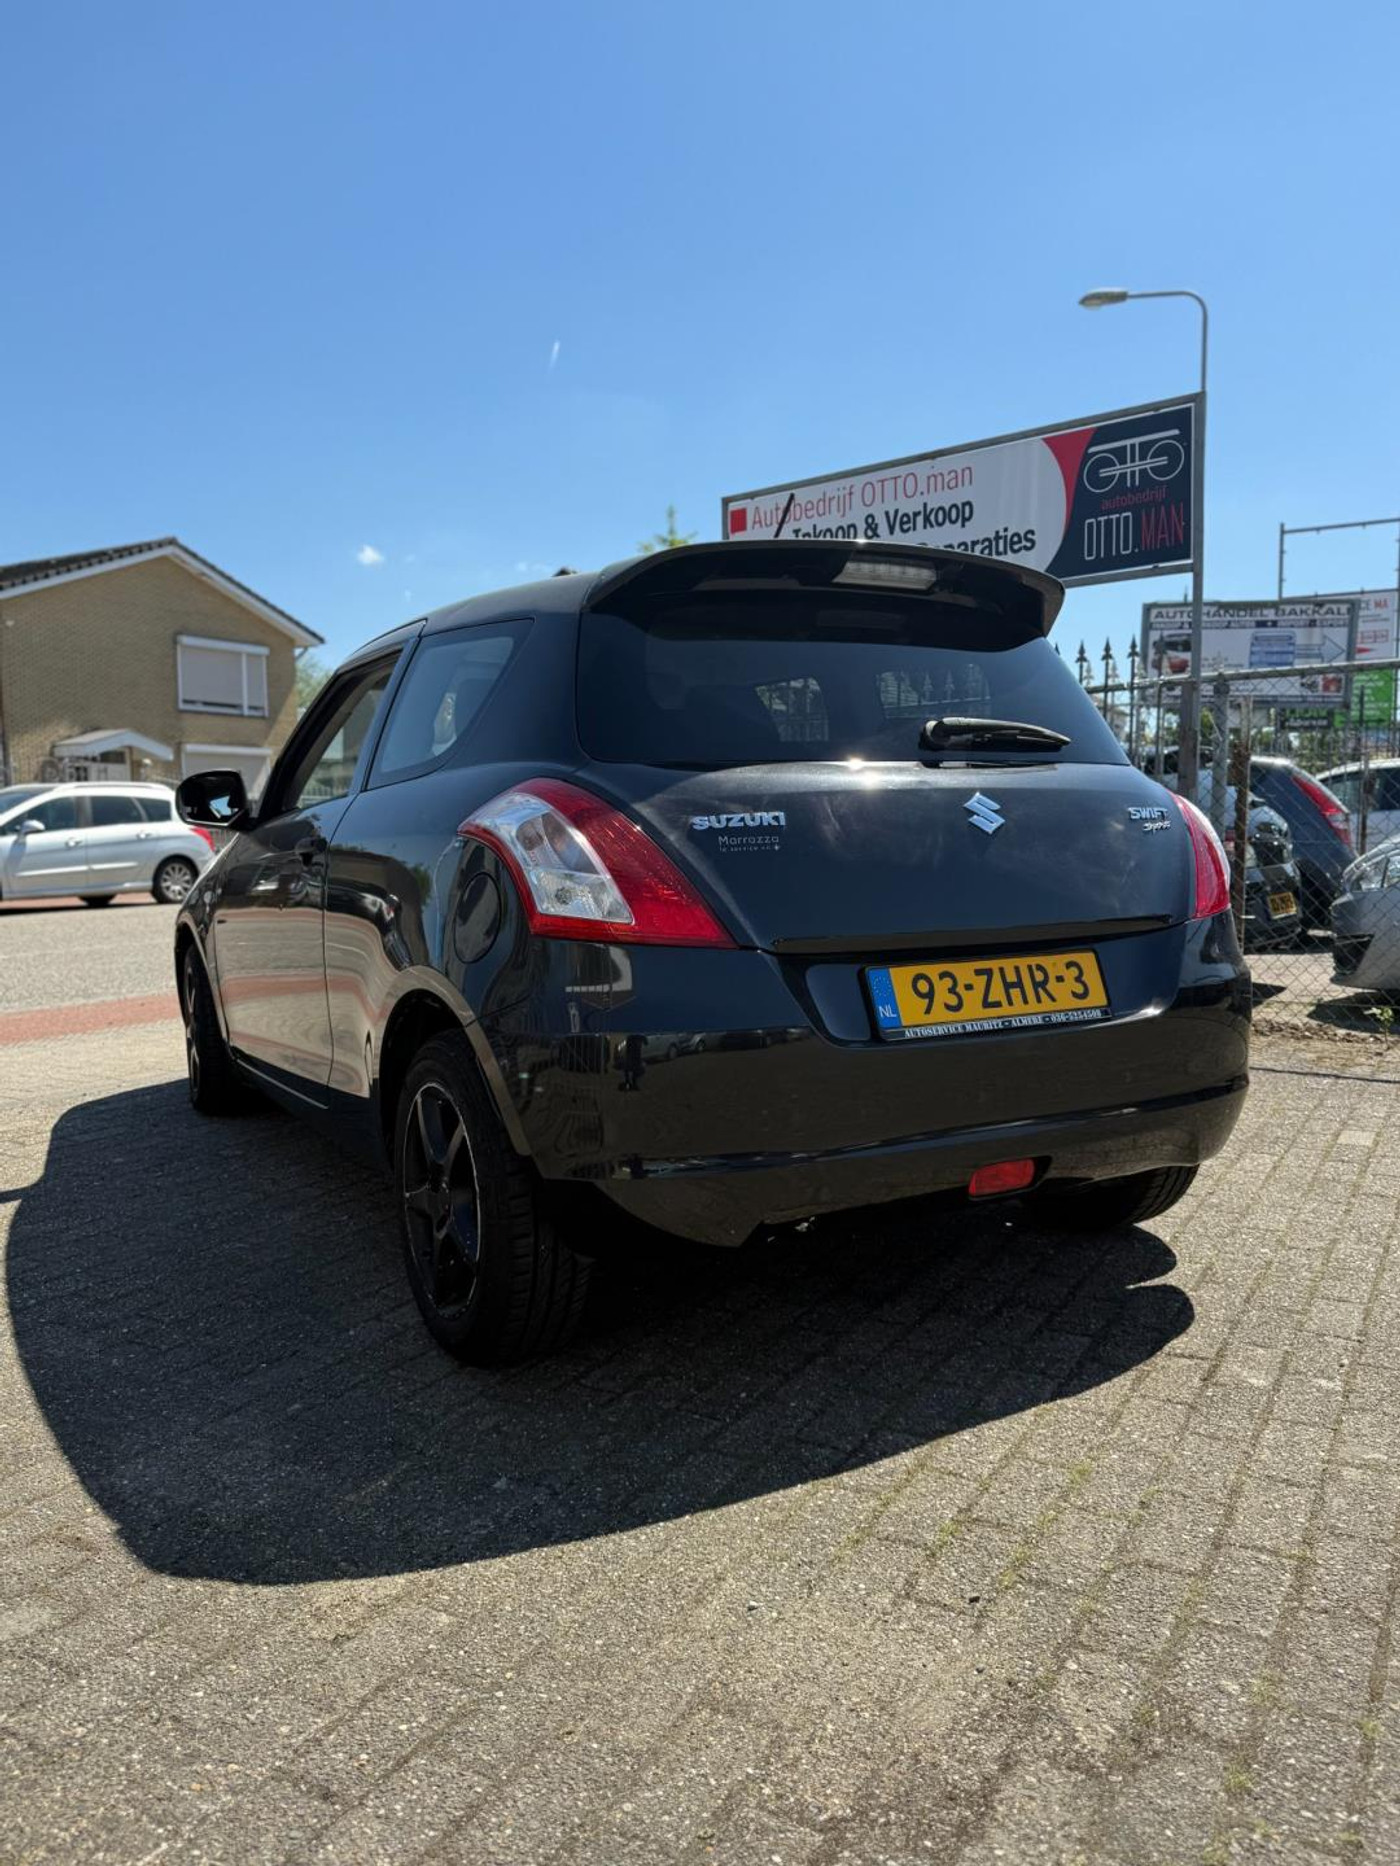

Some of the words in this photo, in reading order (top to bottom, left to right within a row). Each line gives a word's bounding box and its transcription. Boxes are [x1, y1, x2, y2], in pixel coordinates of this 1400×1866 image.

[861, 466, 974, 508] OTTO.man
[1101, 484, 1168, 511] autobedrijf
[863, 513, 880, 540] &
[884, 500, 975, 536] Verkoop
[1084, 502, 1184, 561] OTTO.MAN
[692, 811, 786, 831] SUZUKI
[911, 960, 1091, 1016] 93-ZHR-3
[878, 1004, 898, 1019] NL
[904, 1022, 963, 1039] AUTOSERVICE
